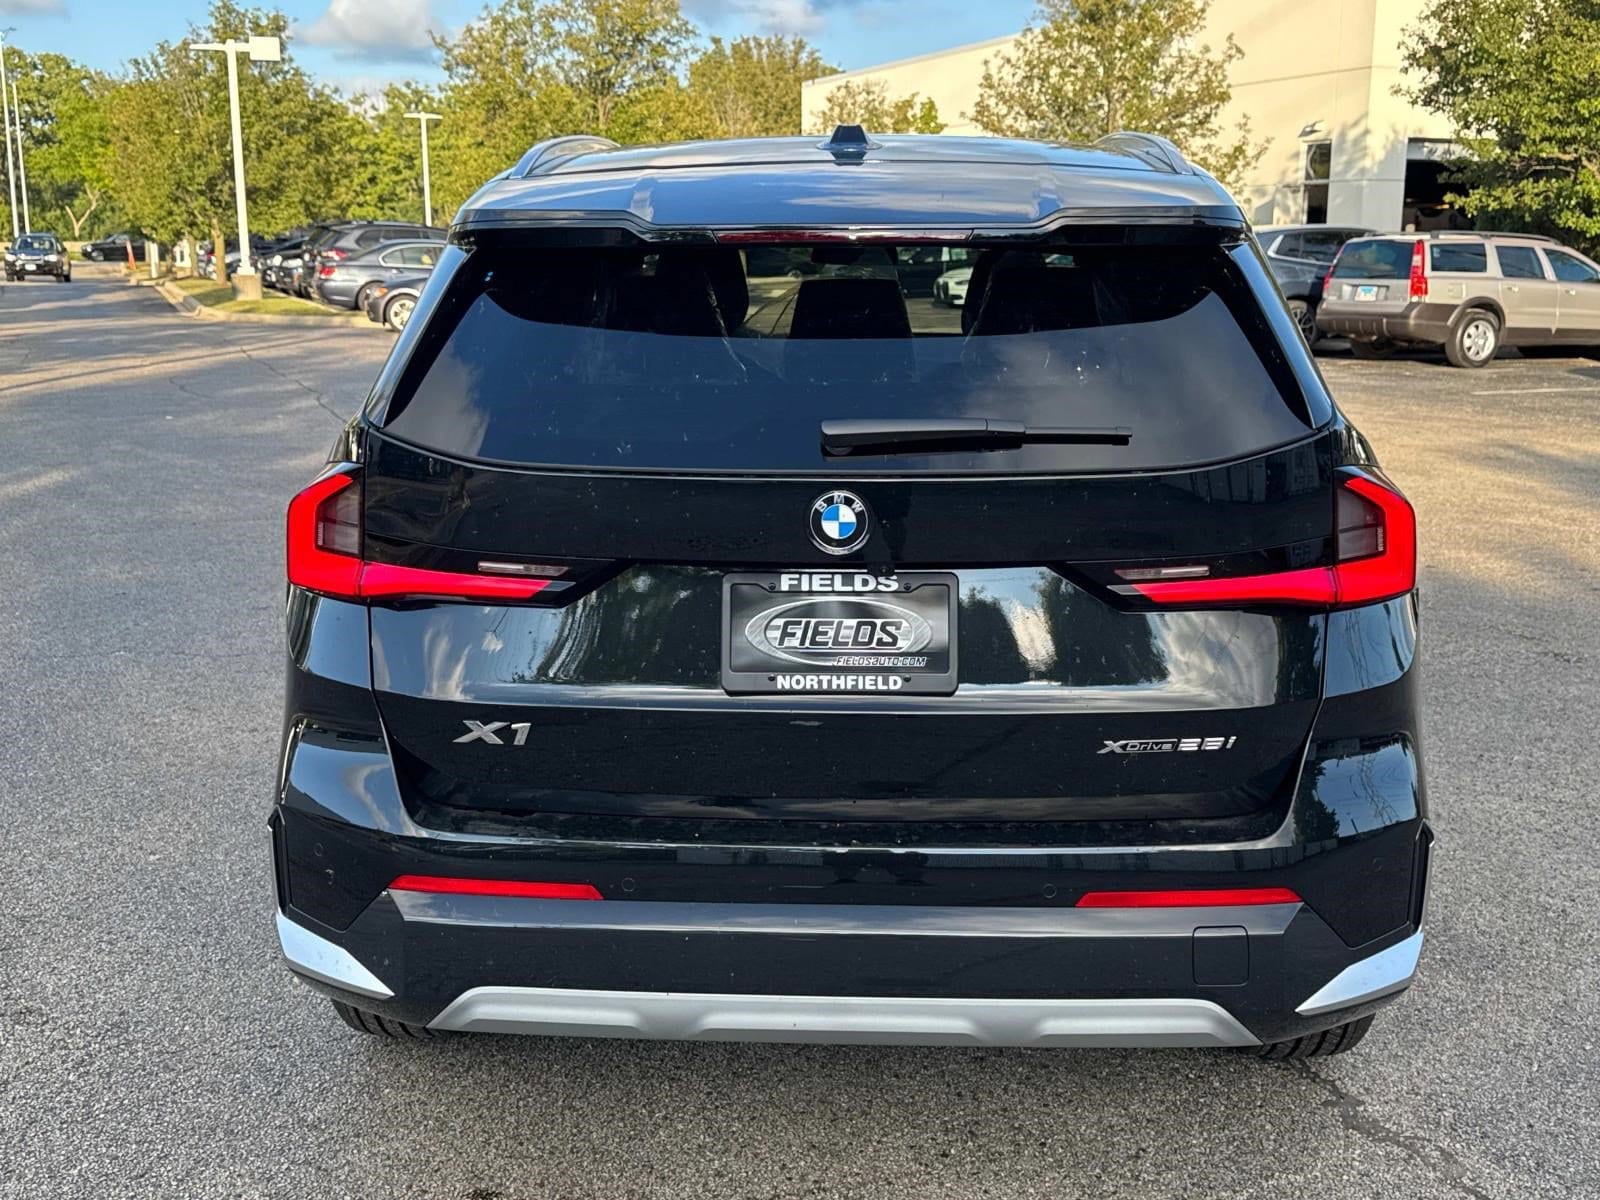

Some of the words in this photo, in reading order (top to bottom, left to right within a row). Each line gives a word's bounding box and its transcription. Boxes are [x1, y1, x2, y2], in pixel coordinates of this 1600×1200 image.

[815, 493, 865, 513] BMW
[780, 574, 899, 592] FIELDS
[776, 620, 902, 648] FIELDS
[776, 674, 903, 690] NORTHFIELD
[452, 719, 532, 746] X1
